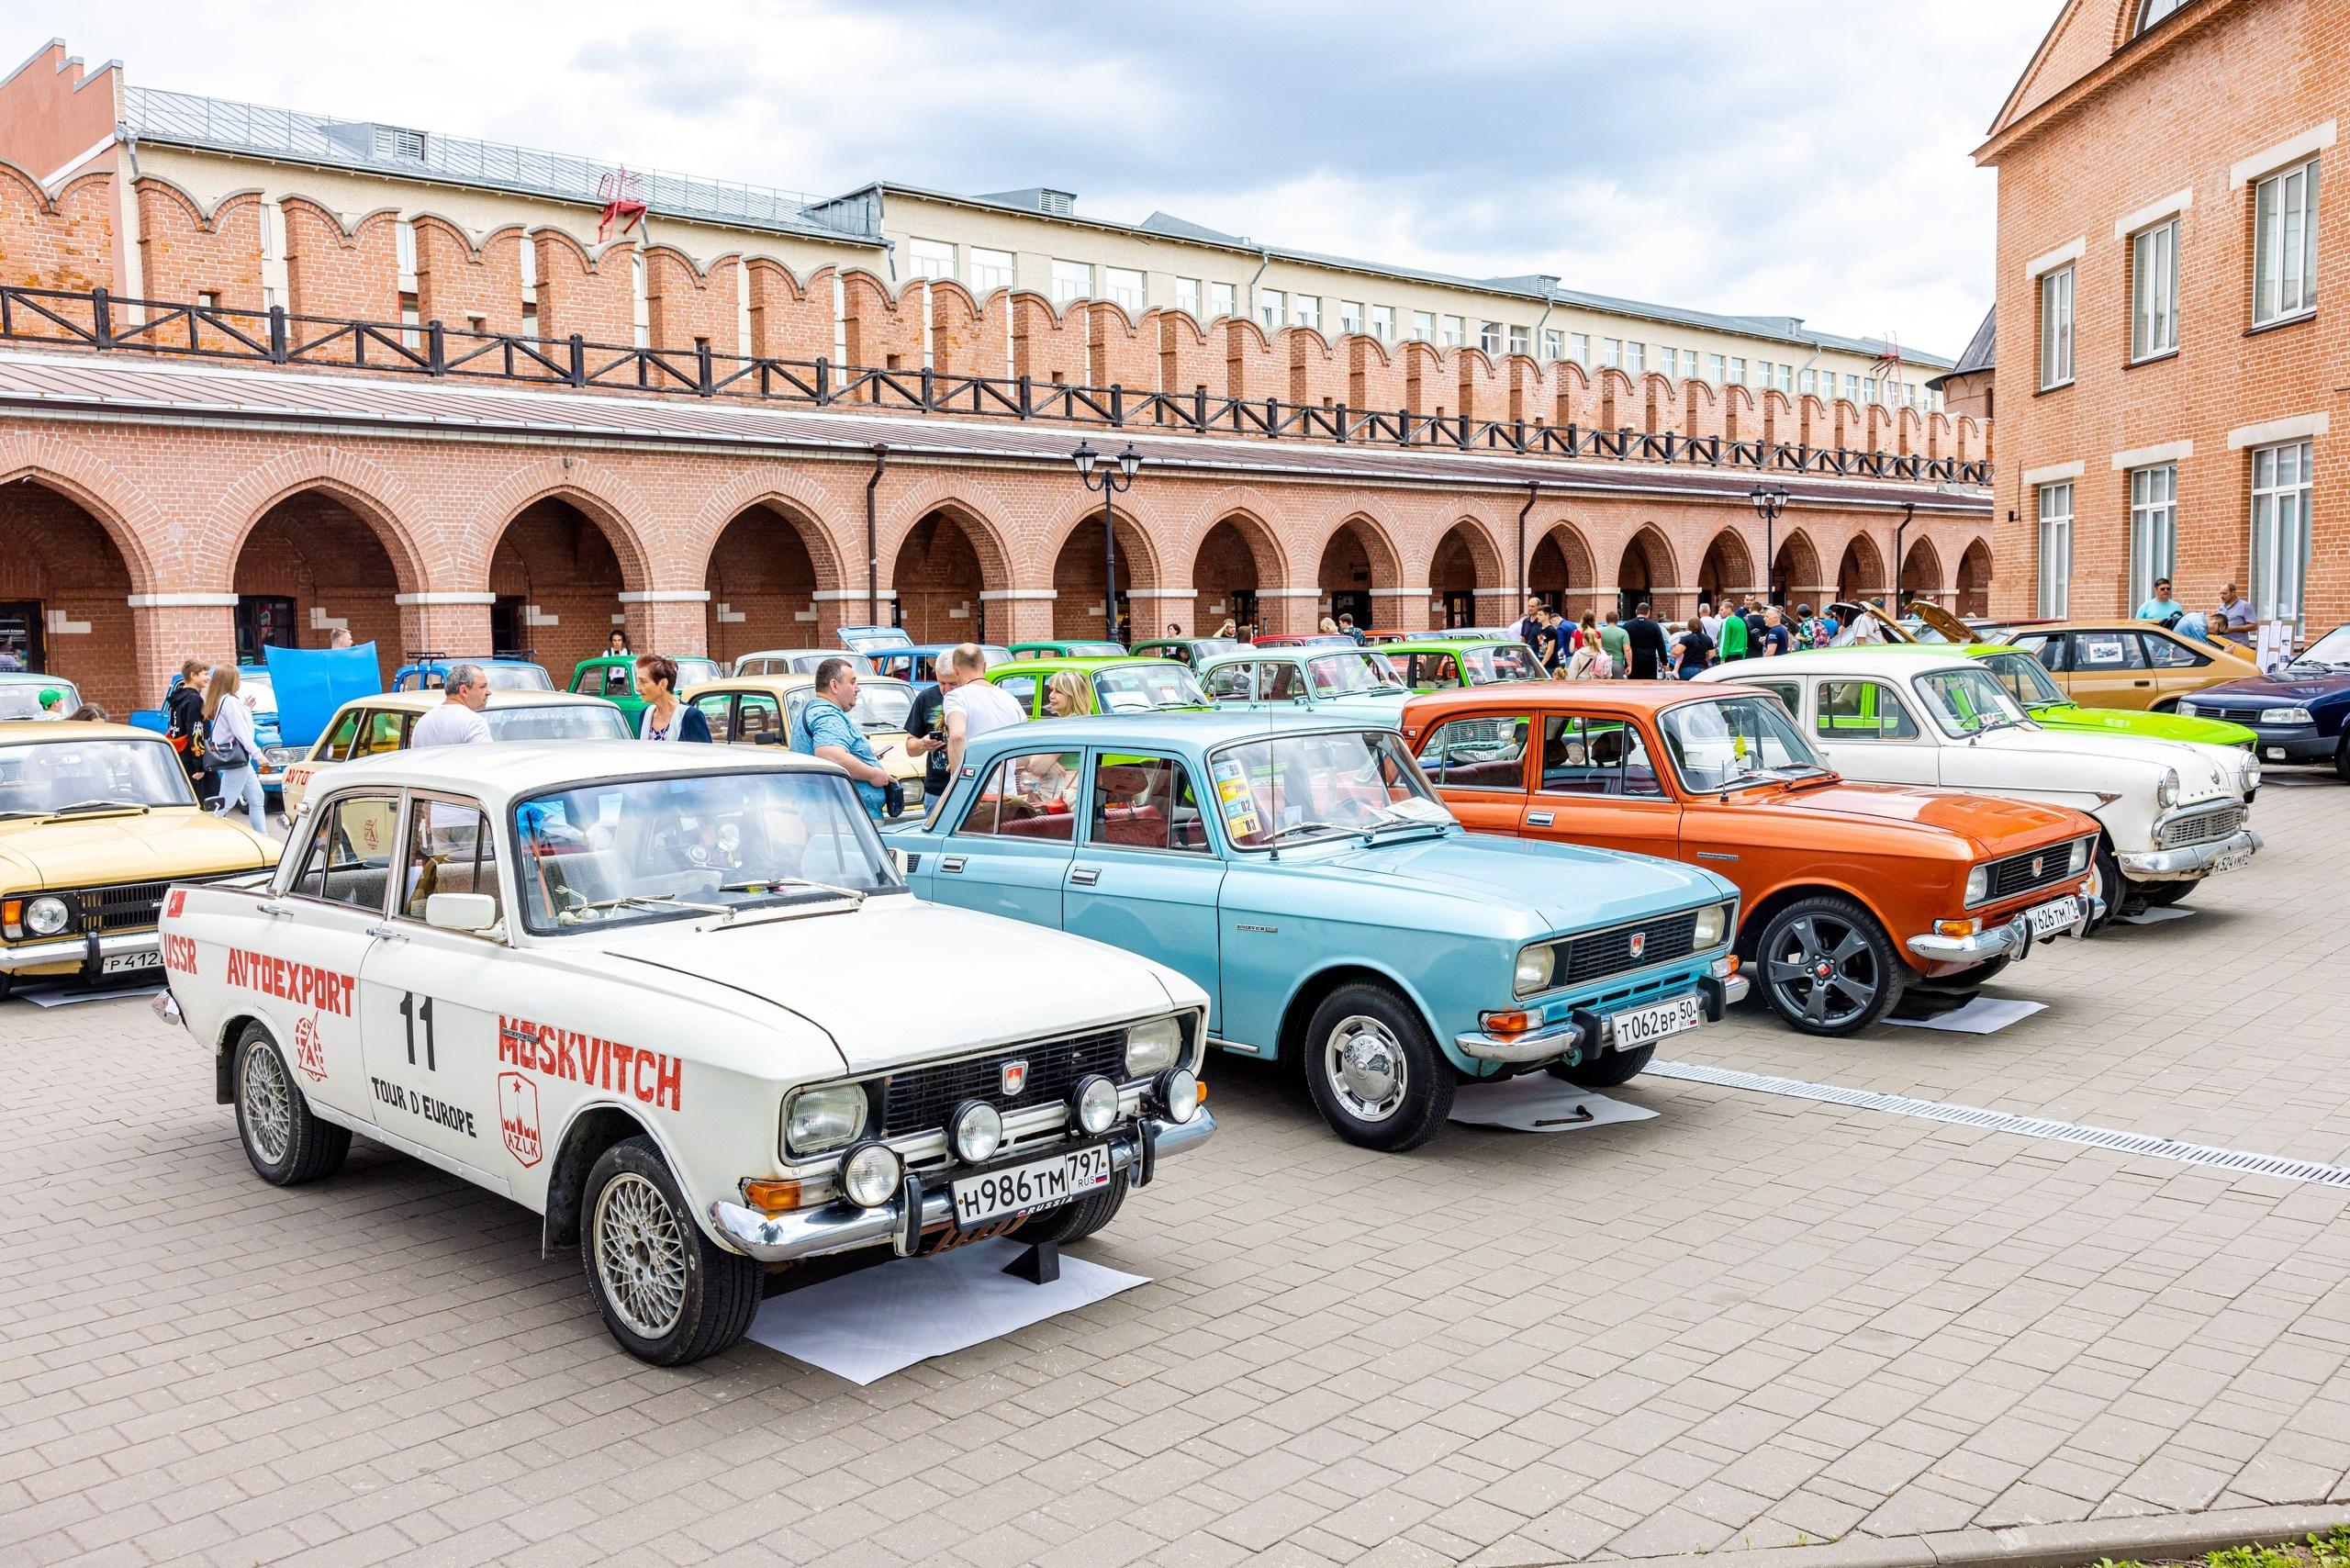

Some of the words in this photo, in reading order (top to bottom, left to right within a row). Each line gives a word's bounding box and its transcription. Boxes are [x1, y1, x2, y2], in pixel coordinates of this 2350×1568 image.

[285, 768, 316, 786] AVTO
[163, 933, 197, 975] USSR
[227, 946, 355, 1018] AVTOEXPORT
[1679, 1001, 1693, 1020] 50
[399, 991, 436, 1072] 11
[498, 1014, 682, 1113] MOSKVITCH
[371, 1076, 408, 1111] TOUR
[508, 1133, 539, 1159] AZLK
[1068, 1149, 1102, 1182] 797
[1078, 1175, 1095, 1188] RUS
[1026, 1195, 1073, 1215] RUSSIA
